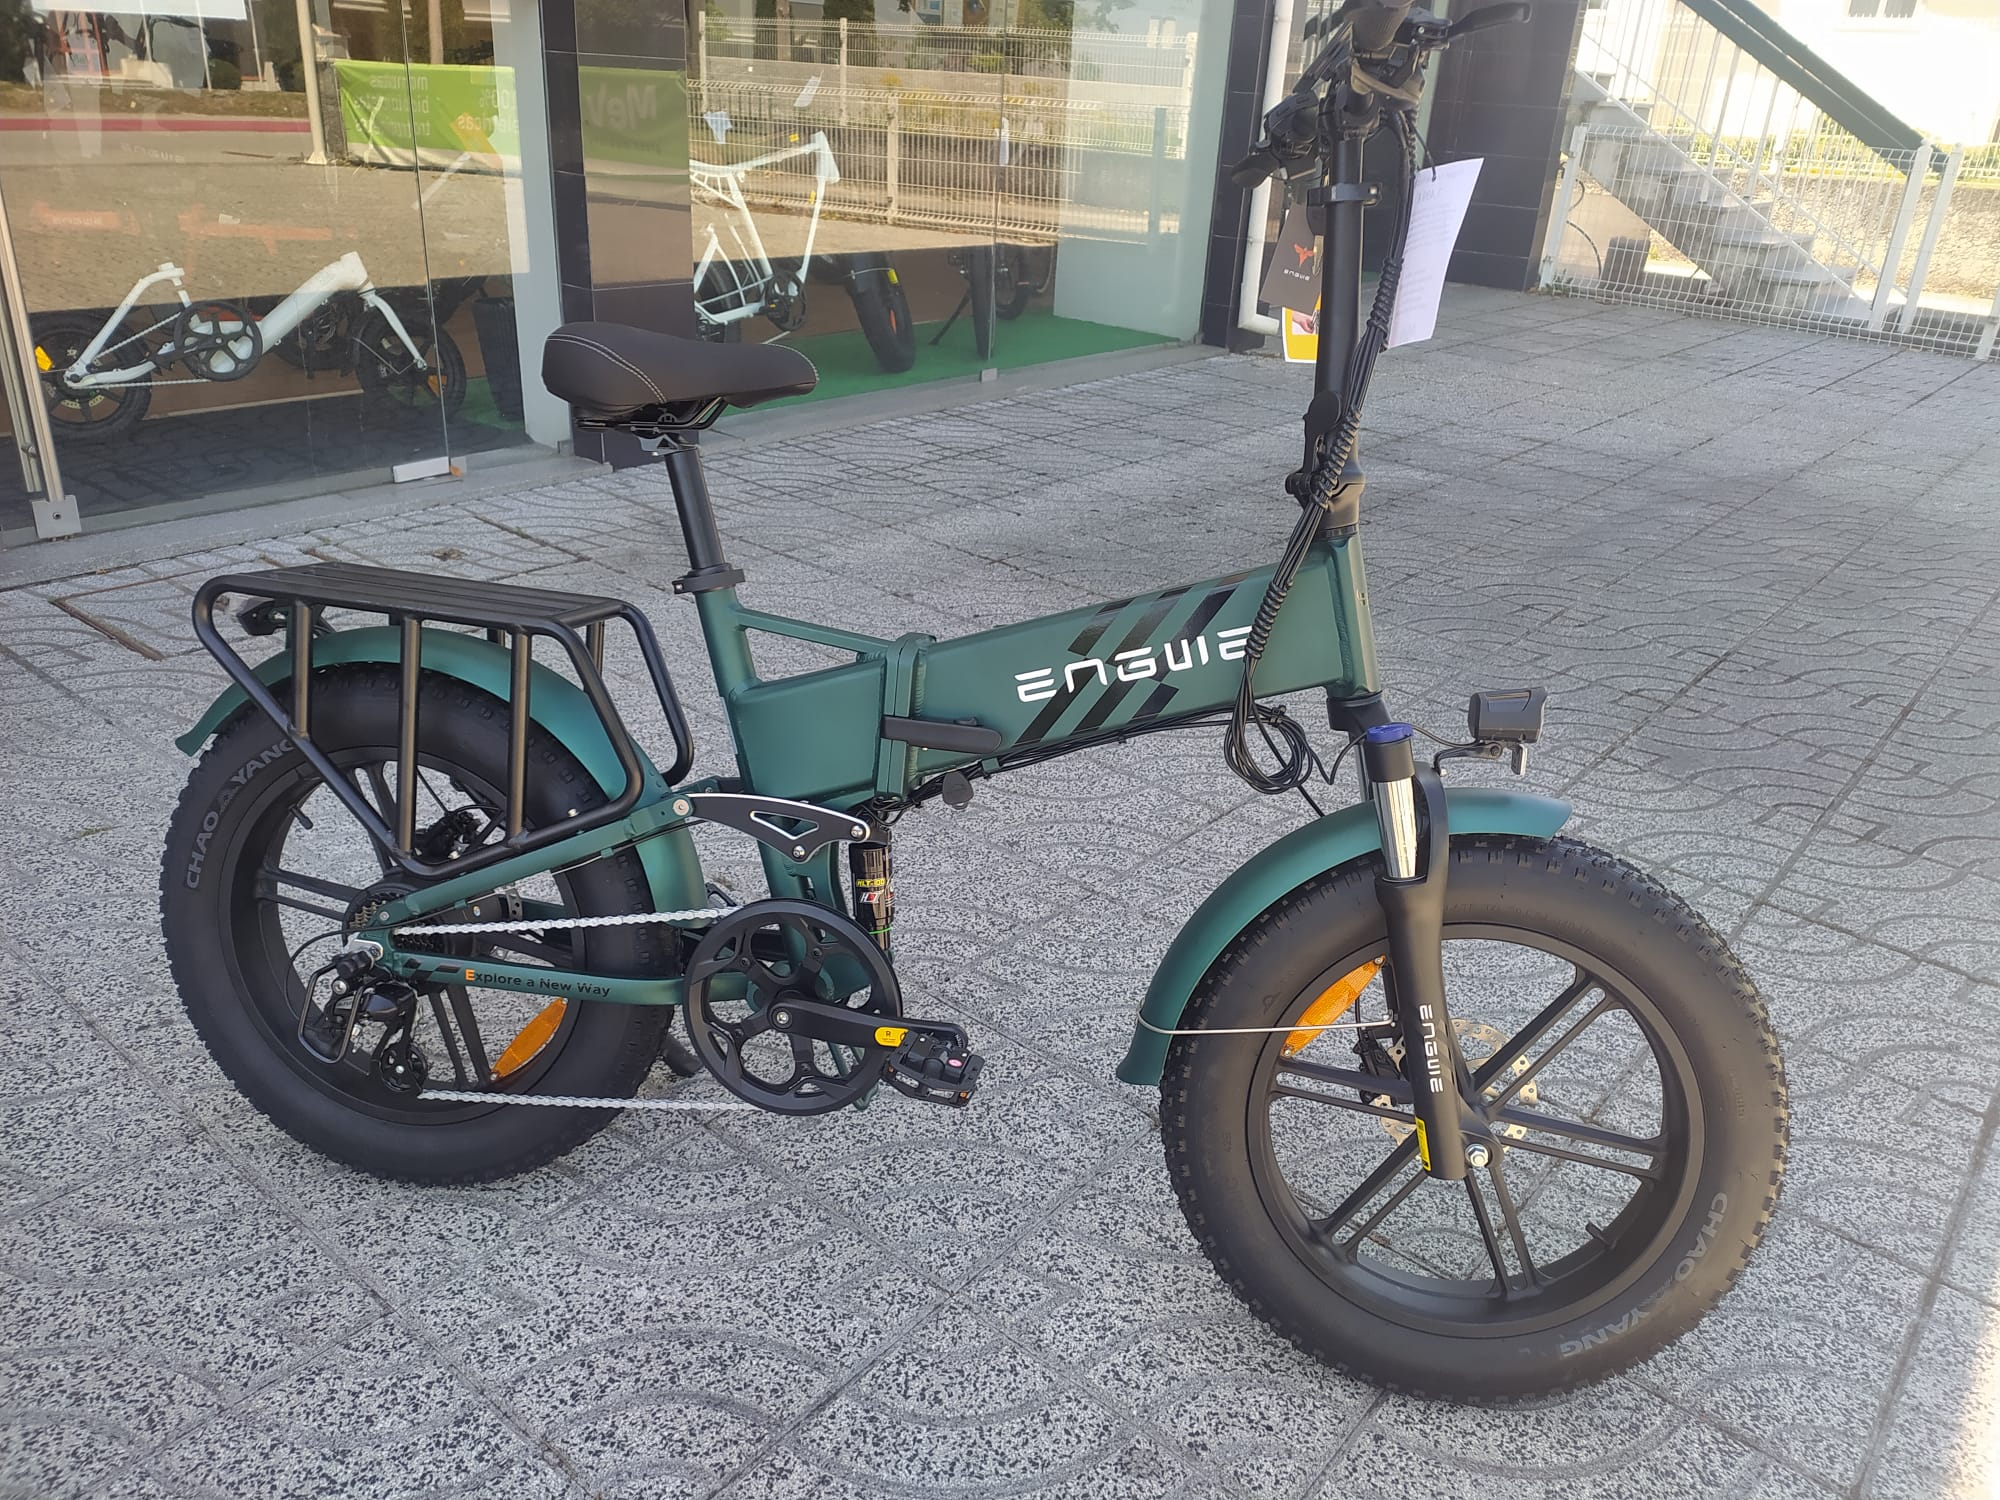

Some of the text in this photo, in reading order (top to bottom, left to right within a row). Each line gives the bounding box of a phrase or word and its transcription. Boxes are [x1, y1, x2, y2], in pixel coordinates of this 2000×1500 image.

[186, 811, 219, 889] CHAO
[464, 968, 611, 998] Explore a New Way
[1559, 1192, 1729, 1358] CHAO YANG
